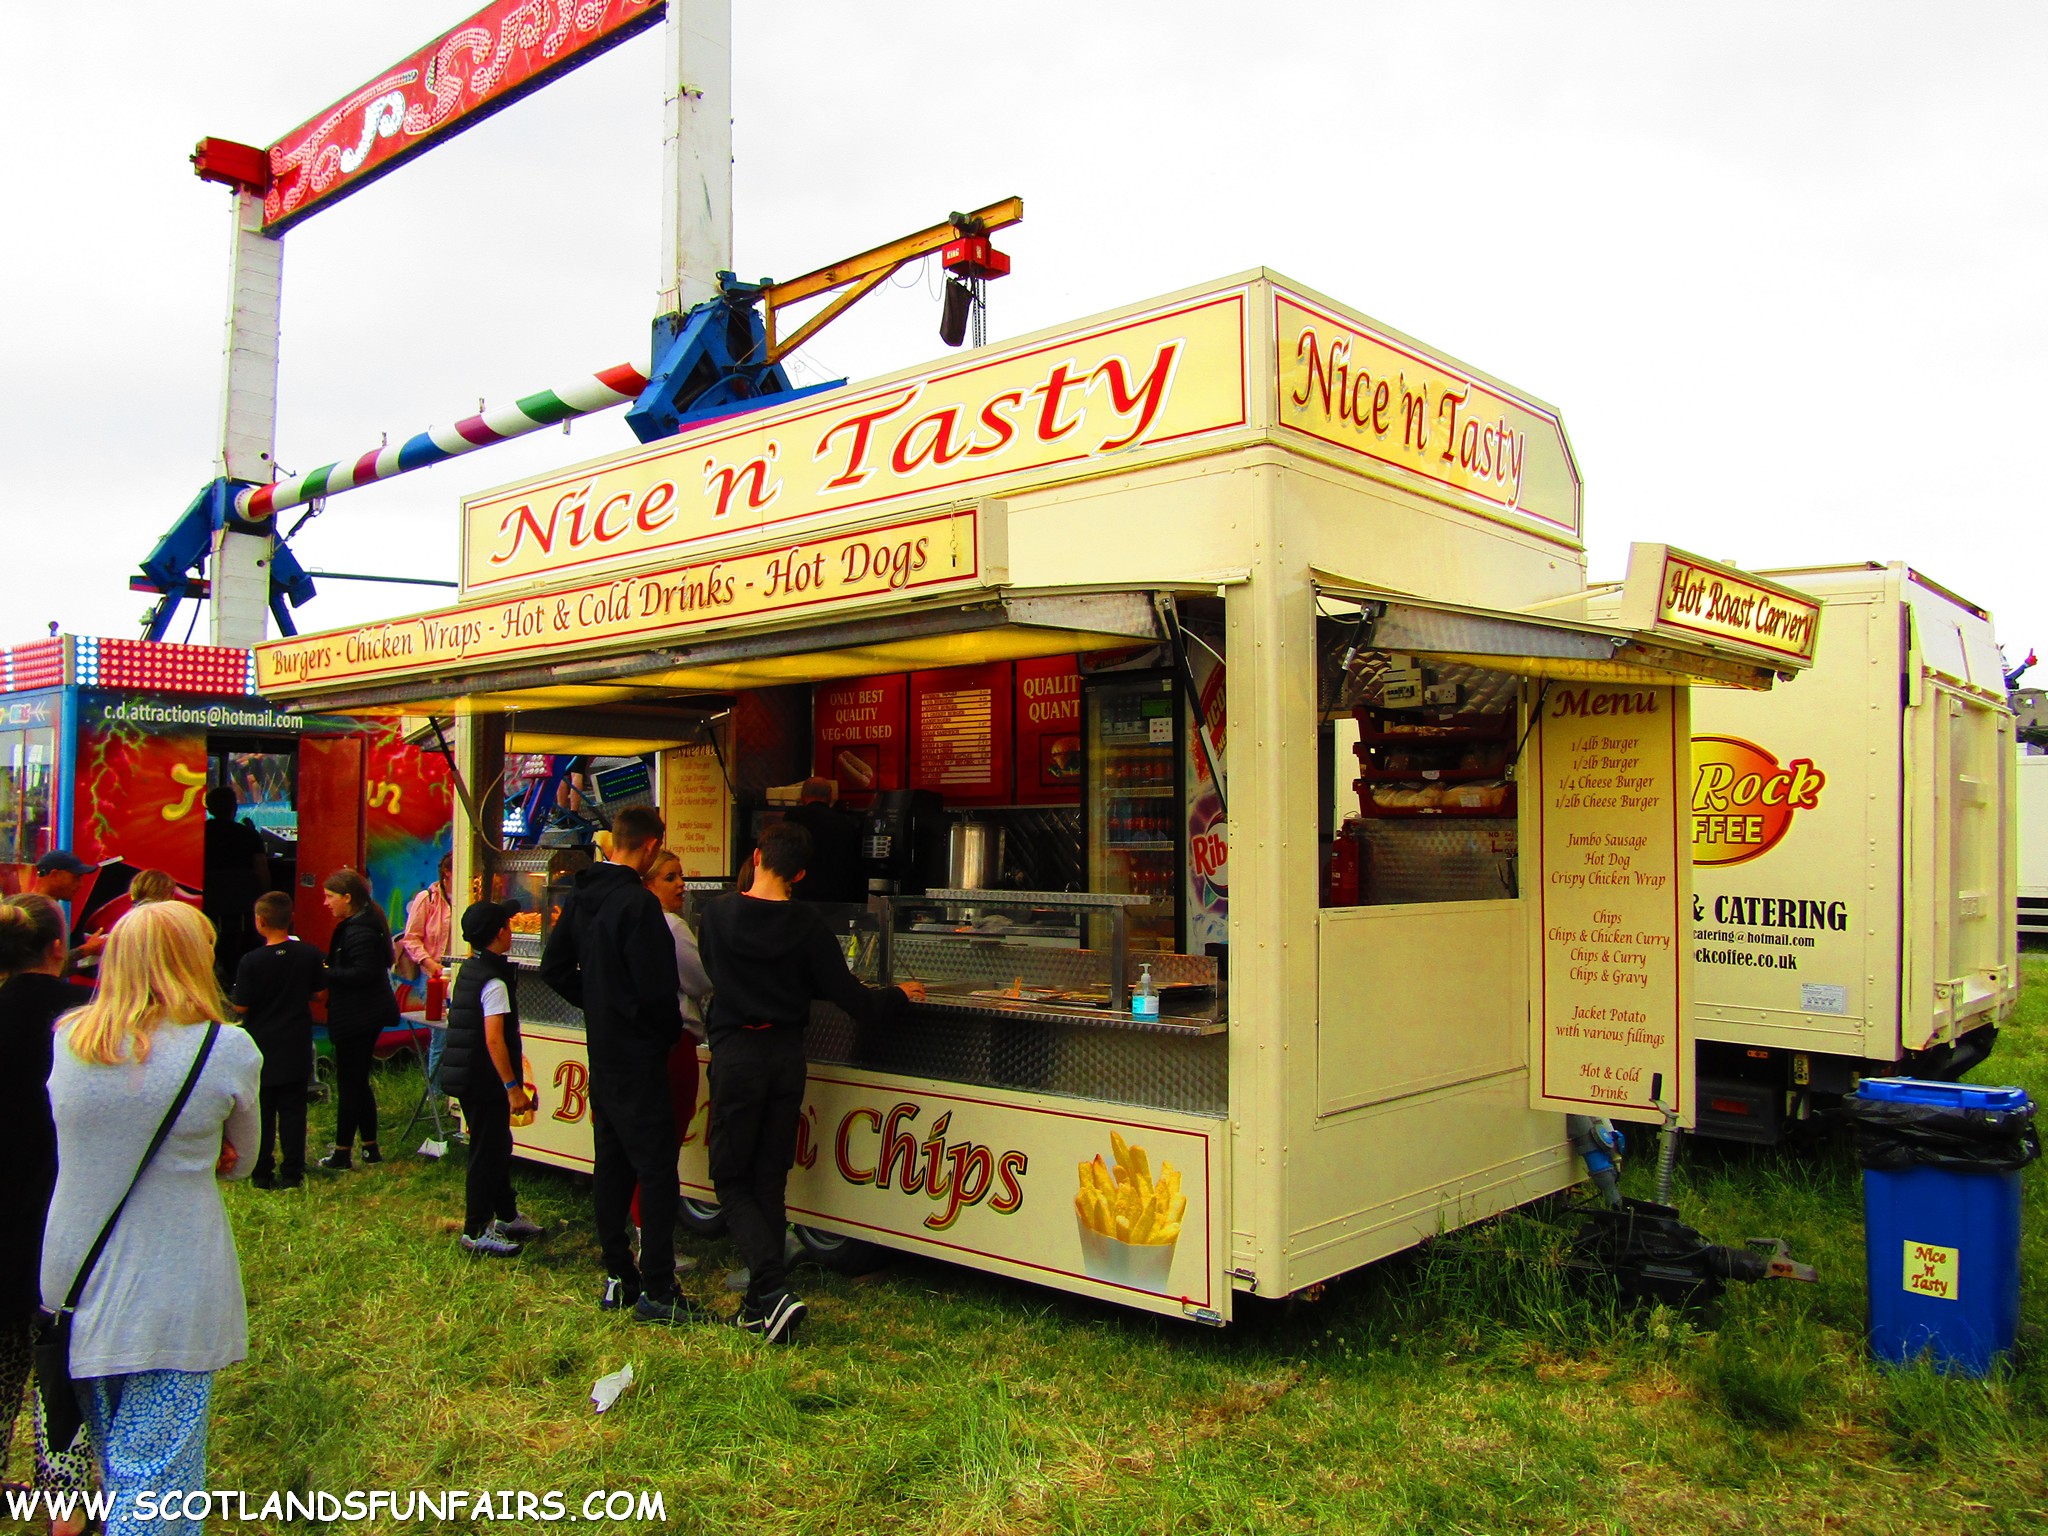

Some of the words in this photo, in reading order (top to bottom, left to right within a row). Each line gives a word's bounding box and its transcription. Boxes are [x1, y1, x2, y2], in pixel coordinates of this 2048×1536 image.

[1293, 328, 1390, 440] Nice
[1439, 384, 1525, 511] Tasty
[489, 476, 679, 564] Nice
[815, 339, 1185, 494] Tasty
[273, 646, 331, 681] Burgers
[346, 624, 413, 664] Chicken
[418, 619, 481, 659] Wraps
[500, 602, 545, 639] Hot
[553, 599, 570, 631] &
[579, 578, 636, 627] Cold
[640, 564, 735, 617] Drinks
[764, 547, 825, 597] Hot
[841, 537, 928, 590] Dogs
[1666, 567, 1706, 616] Hot
[1705, 581, 1755, 629] Roast
[1756, 596, 1813, 653] Carvery
[830, 692, 855, 706] ONLY
[859, 689, 884, 704] BEST
[1552, 687, 1659, 718] Menu
[104, 702, 303, 728] c.d.attractions@hotmail.com
[836, 707, 878, 724] QUALITY
[865, 725, 892, 739] USED
[1571, 736, 1598, 753] 1/4lb
[1602, 737, 1639, 754] Burger
[1573, 756, 1598, 770] 1/2lb
[1602, 756, 1639, 773] Burger
[1560, 775, 1576, 791] 1/4
[1579, 774, 1612, 789] Cheese
[1616, 775, 1655, 792] Burger
[1692, 762, 1822, 812] Rock
[1555, 795, 1580, 808] 1/2lb
[1583, 794, 1617, 808] Cheese
[1620, 795, 1660, 811] Burger
[1566, 832, 1601, 848] Jumbo
[1604, 833, 1648, 851] Sausage
[1584, 853, 1604, 866] Hot
[1608, 853, 1631, 870] Dog
[1551, 871, 1585, 888] Crispy
[1588, 871, 1630, 886] Chicken
[1634, 871, 1666, 890] Wrap
[1593, 909, 1622, 929] Chips
[1714, 895, 1848, 931] CATERING
[1548, 927, 1576, 946] Chips
[1579, 930, 1587, 942] &
[1591, 928, 1632, 944] Chicken
[1636, 930, 1670, 950] Curry
[1570, 947, 1598, 966] Chips
[1601, 950, 1609, 963] &
[1613, 950, 1646, 969] Curry
[1570, 967, 1598, 985] Chips
[1601, 969, 1609, 982] &
[1613, 969, 1648, 988] Gravy
[1572, 1005, 1606, 1021] Jacket
[1609, 1008, 1646, 1023] Potato
[1556, 1024, 1580, 1038] with
[1583, 1027, 1624, 1042] various
[1624, 1027, 1665, 1049] fillings
[1580, 1063, 1600, 1079] Hot
[1604, 1066, 1612, 1079] &
[1615, 1066, 1642, 1083] Cold
[1591, 1084, 1628, 1101] Drinks
[835, 1104, 1028, 1230] Chips
[1914, 1247, 1946, 1264] Nice
[1912, 1274, 1948, 1297] Tasty
